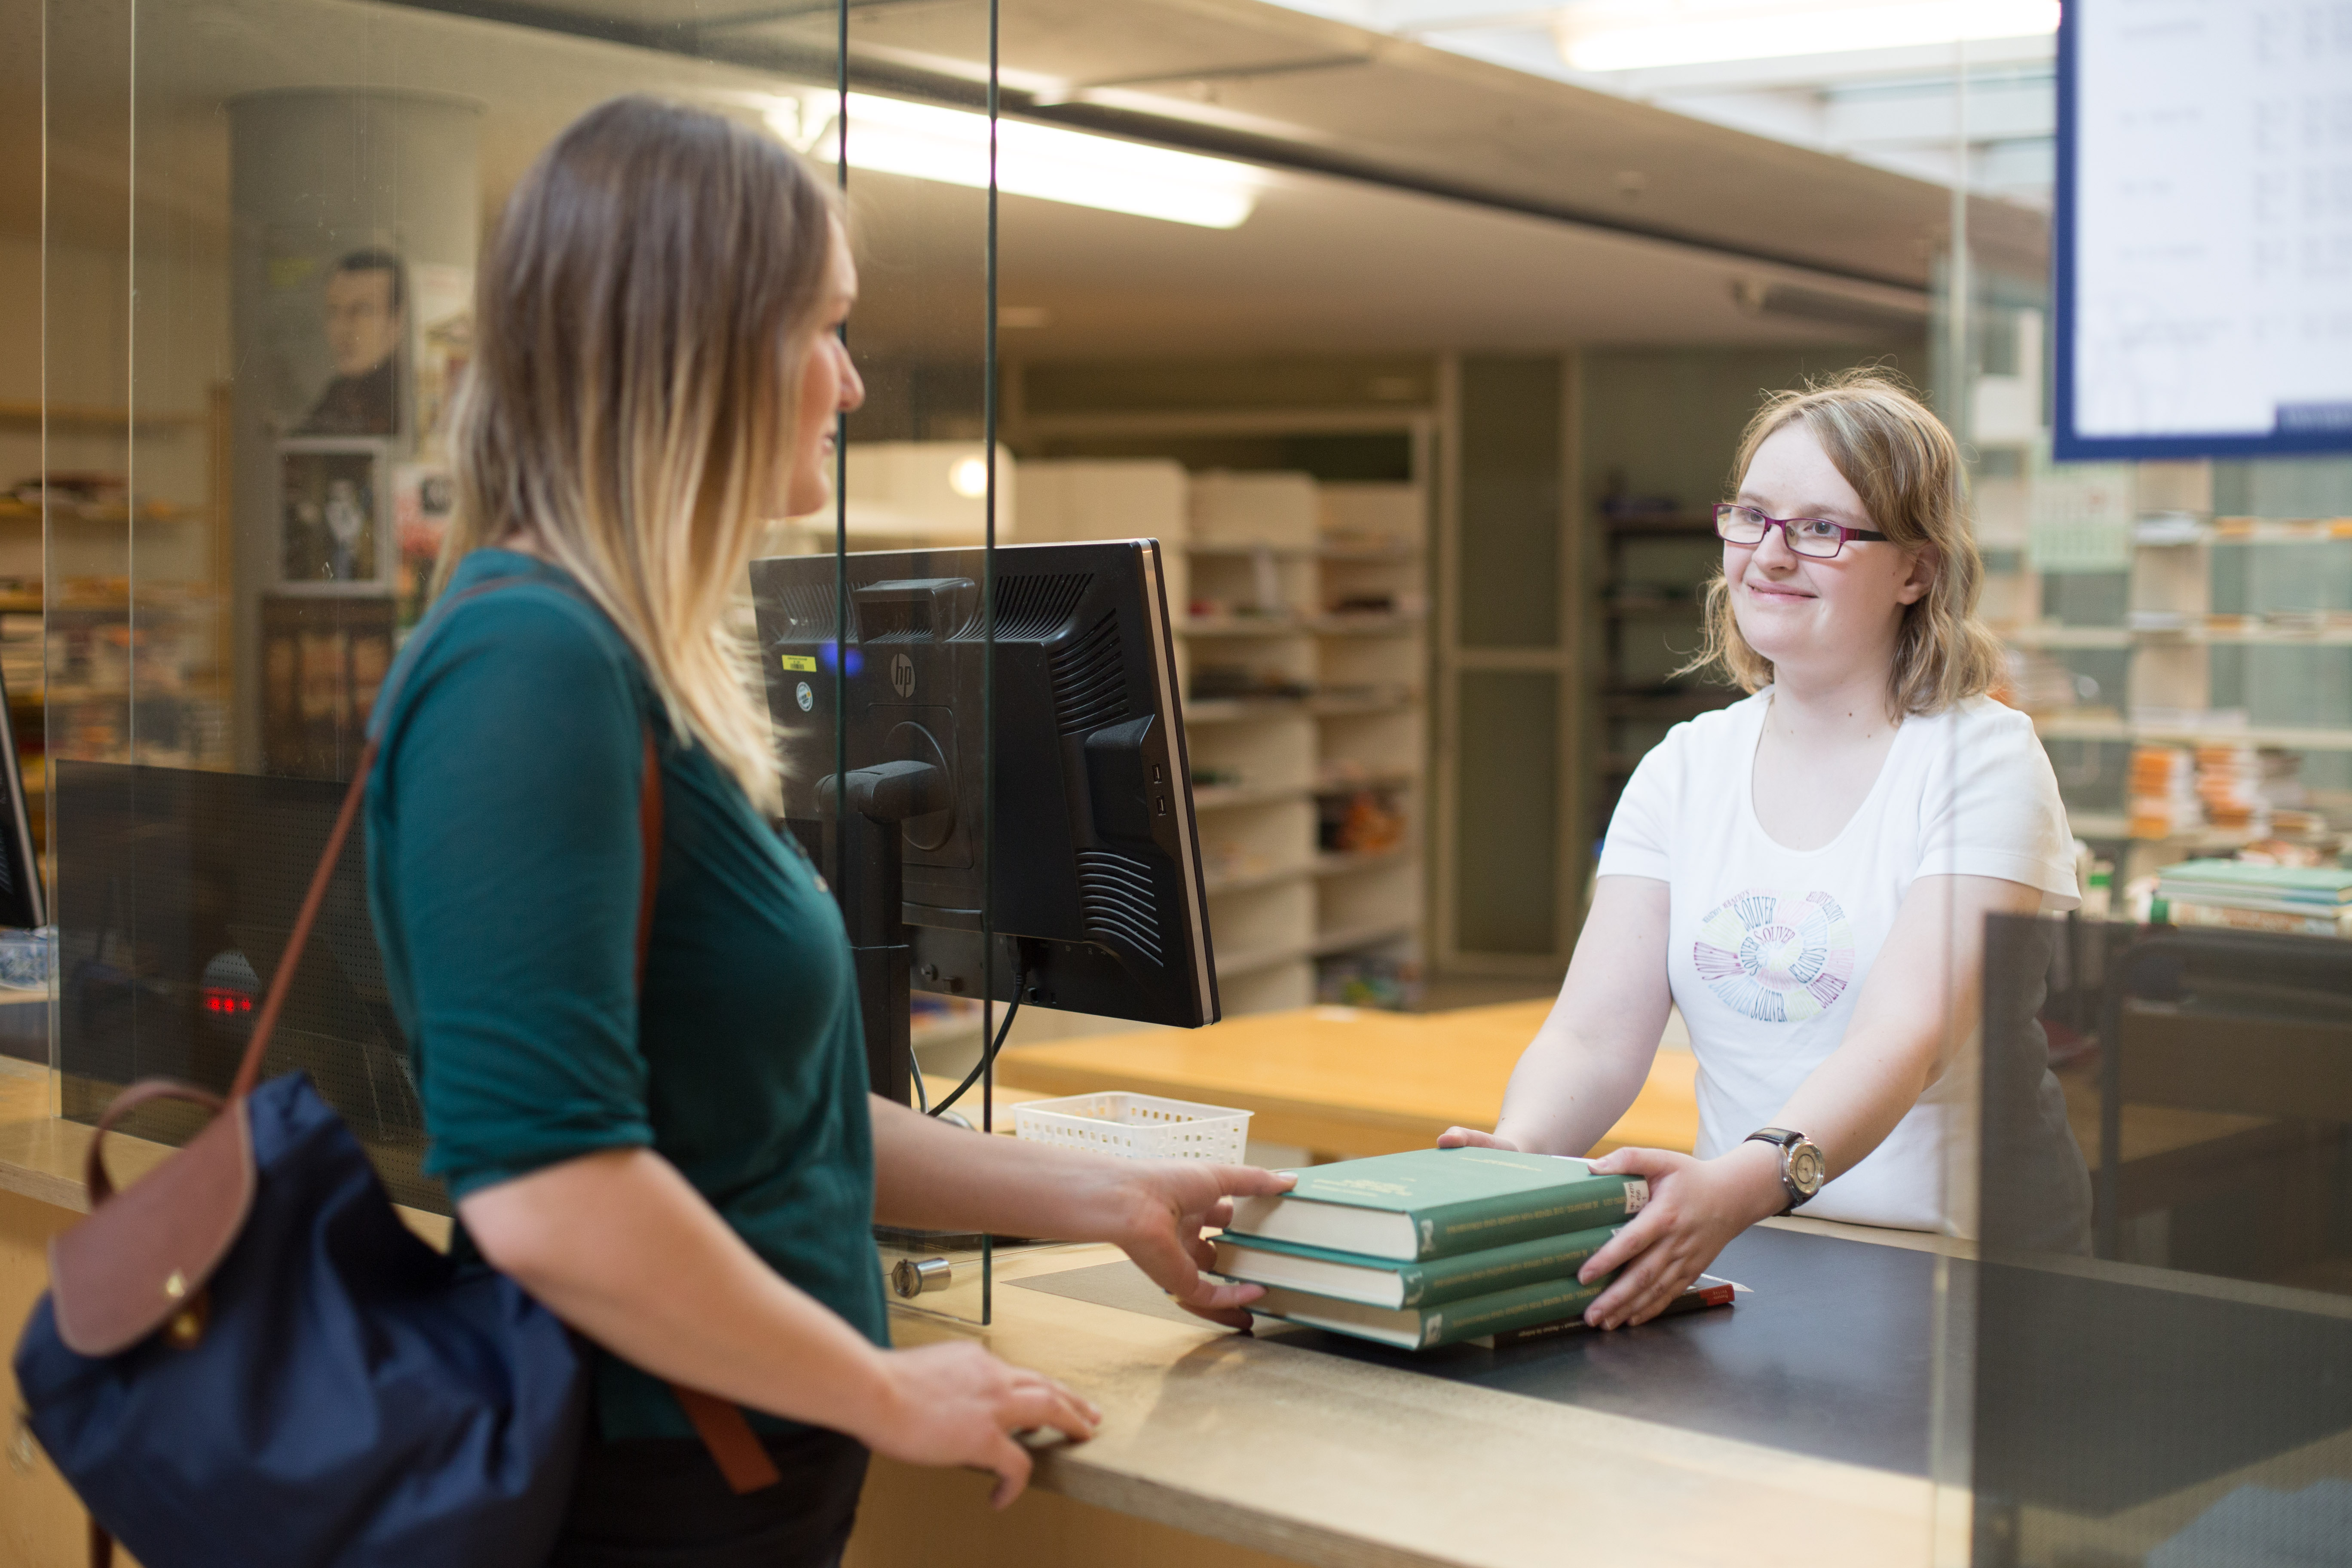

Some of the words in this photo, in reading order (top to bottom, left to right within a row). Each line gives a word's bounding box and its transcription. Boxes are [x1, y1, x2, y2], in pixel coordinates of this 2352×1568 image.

[893, 654, 913, 697] hp
[1734, 896, 1776, 931] S.OLIVER
[1754, 926, 1795, 945] S.OLIVER
[1741, 937, 1762, 976] S.OLIVER
[1788, 948, 1827, 983] S.OLIVER
